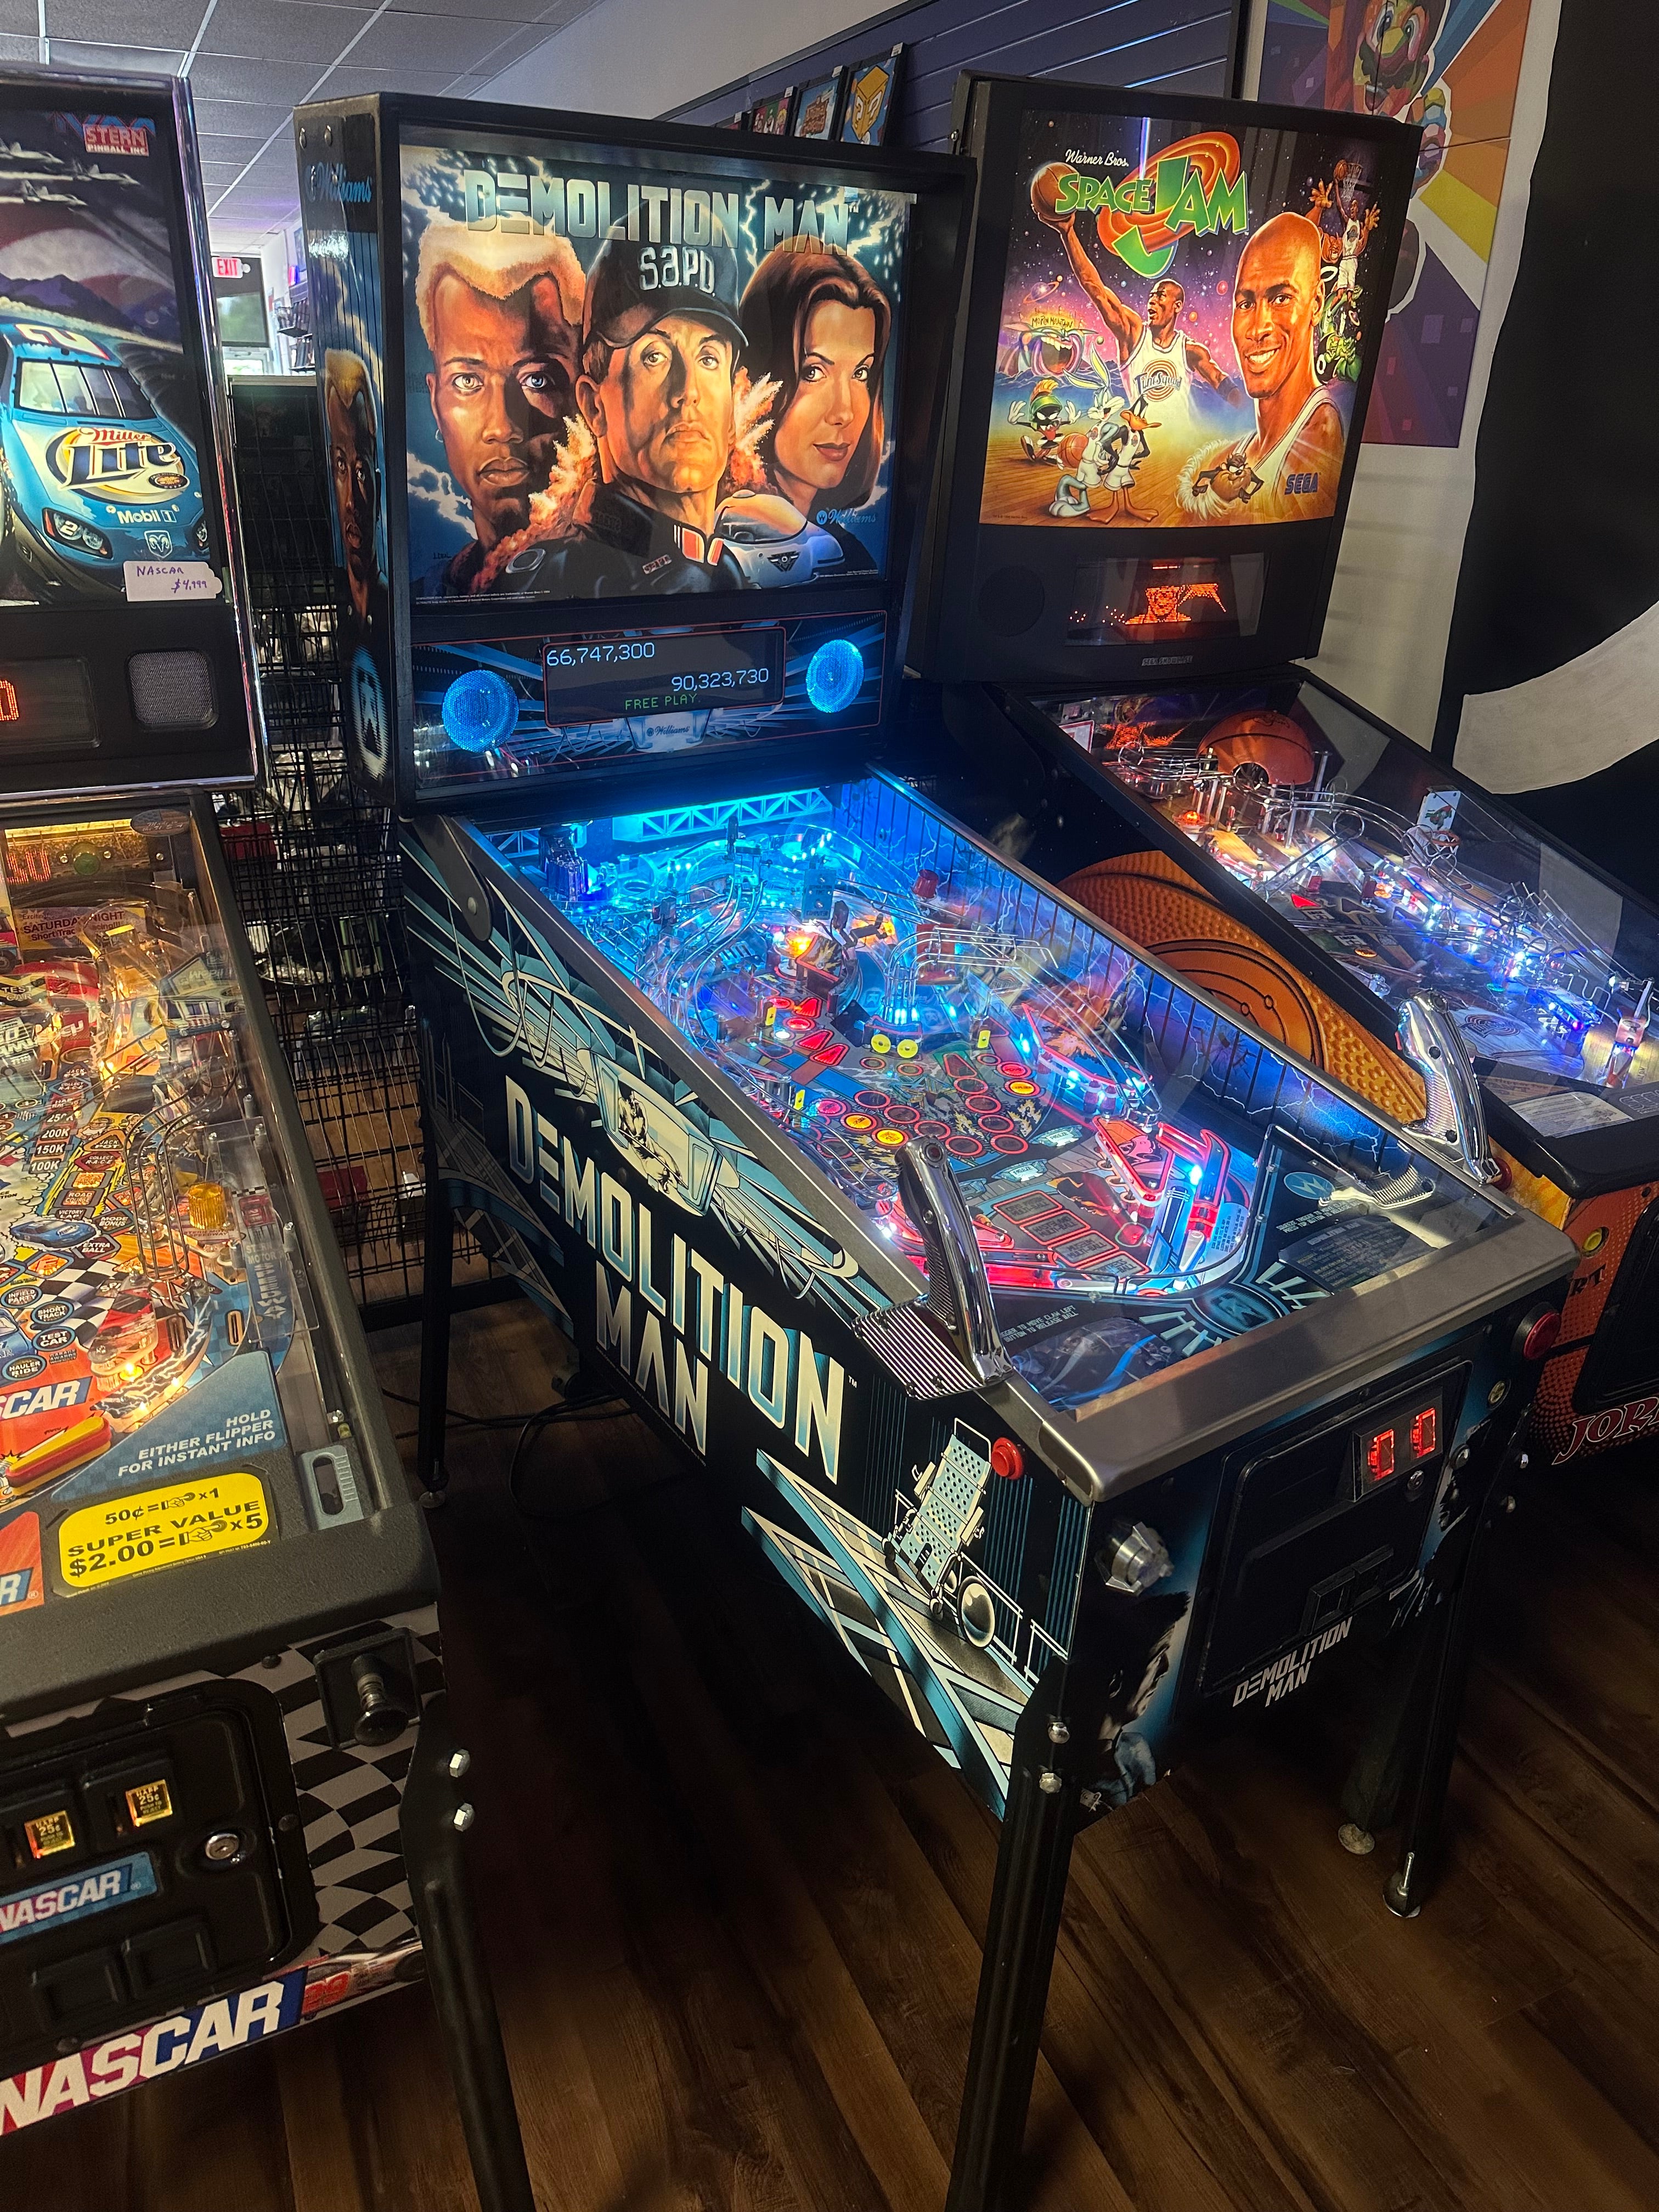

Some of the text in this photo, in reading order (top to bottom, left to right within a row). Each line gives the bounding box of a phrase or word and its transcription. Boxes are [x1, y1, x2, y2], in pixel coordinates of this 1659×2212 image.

[86, 125, 147, 147] STERN
[1065, 149, 1103, 166] Warner
[464, 169, 849, 256] DEMOLITION MAN
[1054, 154, 1250, 279] SPACE JAM
[217, 258, 238, 276] EXIT
[78, 427, 152, 442] Miller
[58, 442, 180, 492] Lite
[1284, 472, 1318, 495] SEGA
[117, 510, 161, 524] Mobil
[828, 508, 877, 525] Williams
[59, 520, 78, 536] 2
[137, 566, 184, 577] NASCAR
[171, 578, 207, 594] $4,999
[546, 642, 656, 667] 66,747,300
[671, 668, 769, 692] 90,323,730
[624, 696, 658, 710] FREE
[654, 725, 690, 736] Williams
[31, 928, 76, 941] Short Trac
[2, 985, 34, 994] TEST
[42, 1127, 71, 1139] 200K
[1049, 1131, 1069, 1140] FREEZE
[36, 1144, 65, 1154] 150K
[31, 1160, 60, 1172] 100K
[1067, 1242, 1107, 1257] MULTI-BALL
[504, 1074, 845, 1485] DEMOLITION
[8, 1289, 36, 1298] INFIELD
[8, 1294, 37, 1304] PARTY
[37, 1305, 66, 1316] SHORT
[38, 1311, 66, 1319] TRACK
[1026, 1317, 1044, 1327] MOVE
[1043, 1311, 1060, 1321] CLAW
[1059, 1305, 1076, 1314] LEFT
[40, 1330, 68, 1340] TEST
[1003, 1330, 1028, 1343] BUTTON
[1035, 1316, 1063, 1330] RELEASE
[1062, 1311, 1079, 1320] BALL
[40, 1337, 68, 1347] CAR
[9, 1361, 41, 1372] HAULER
[595, 1260, 709, 1457] MAN
[12, 1367, 38, 1377] RIDE
[225, 1409, 271, 1427] HOLD
[138, 1419, 274, 1460] EITHER FLIPPER
[117, 1430, 276, 1477] FOR INSTANT INFO
[67, 1500, 261, 1557] SUPER VALUE
[1232, 1617, 1353, 1708] DEMOLITION
[1265, 1662, 1311, 1708] MAN
[138, 1793, 160, 1805] 25¢
[39, 1824, 61, 1837] 25¢
[0, 1869, 124, 1932] NASCAR
[0, 1979, 286, 2134] NASCAR
